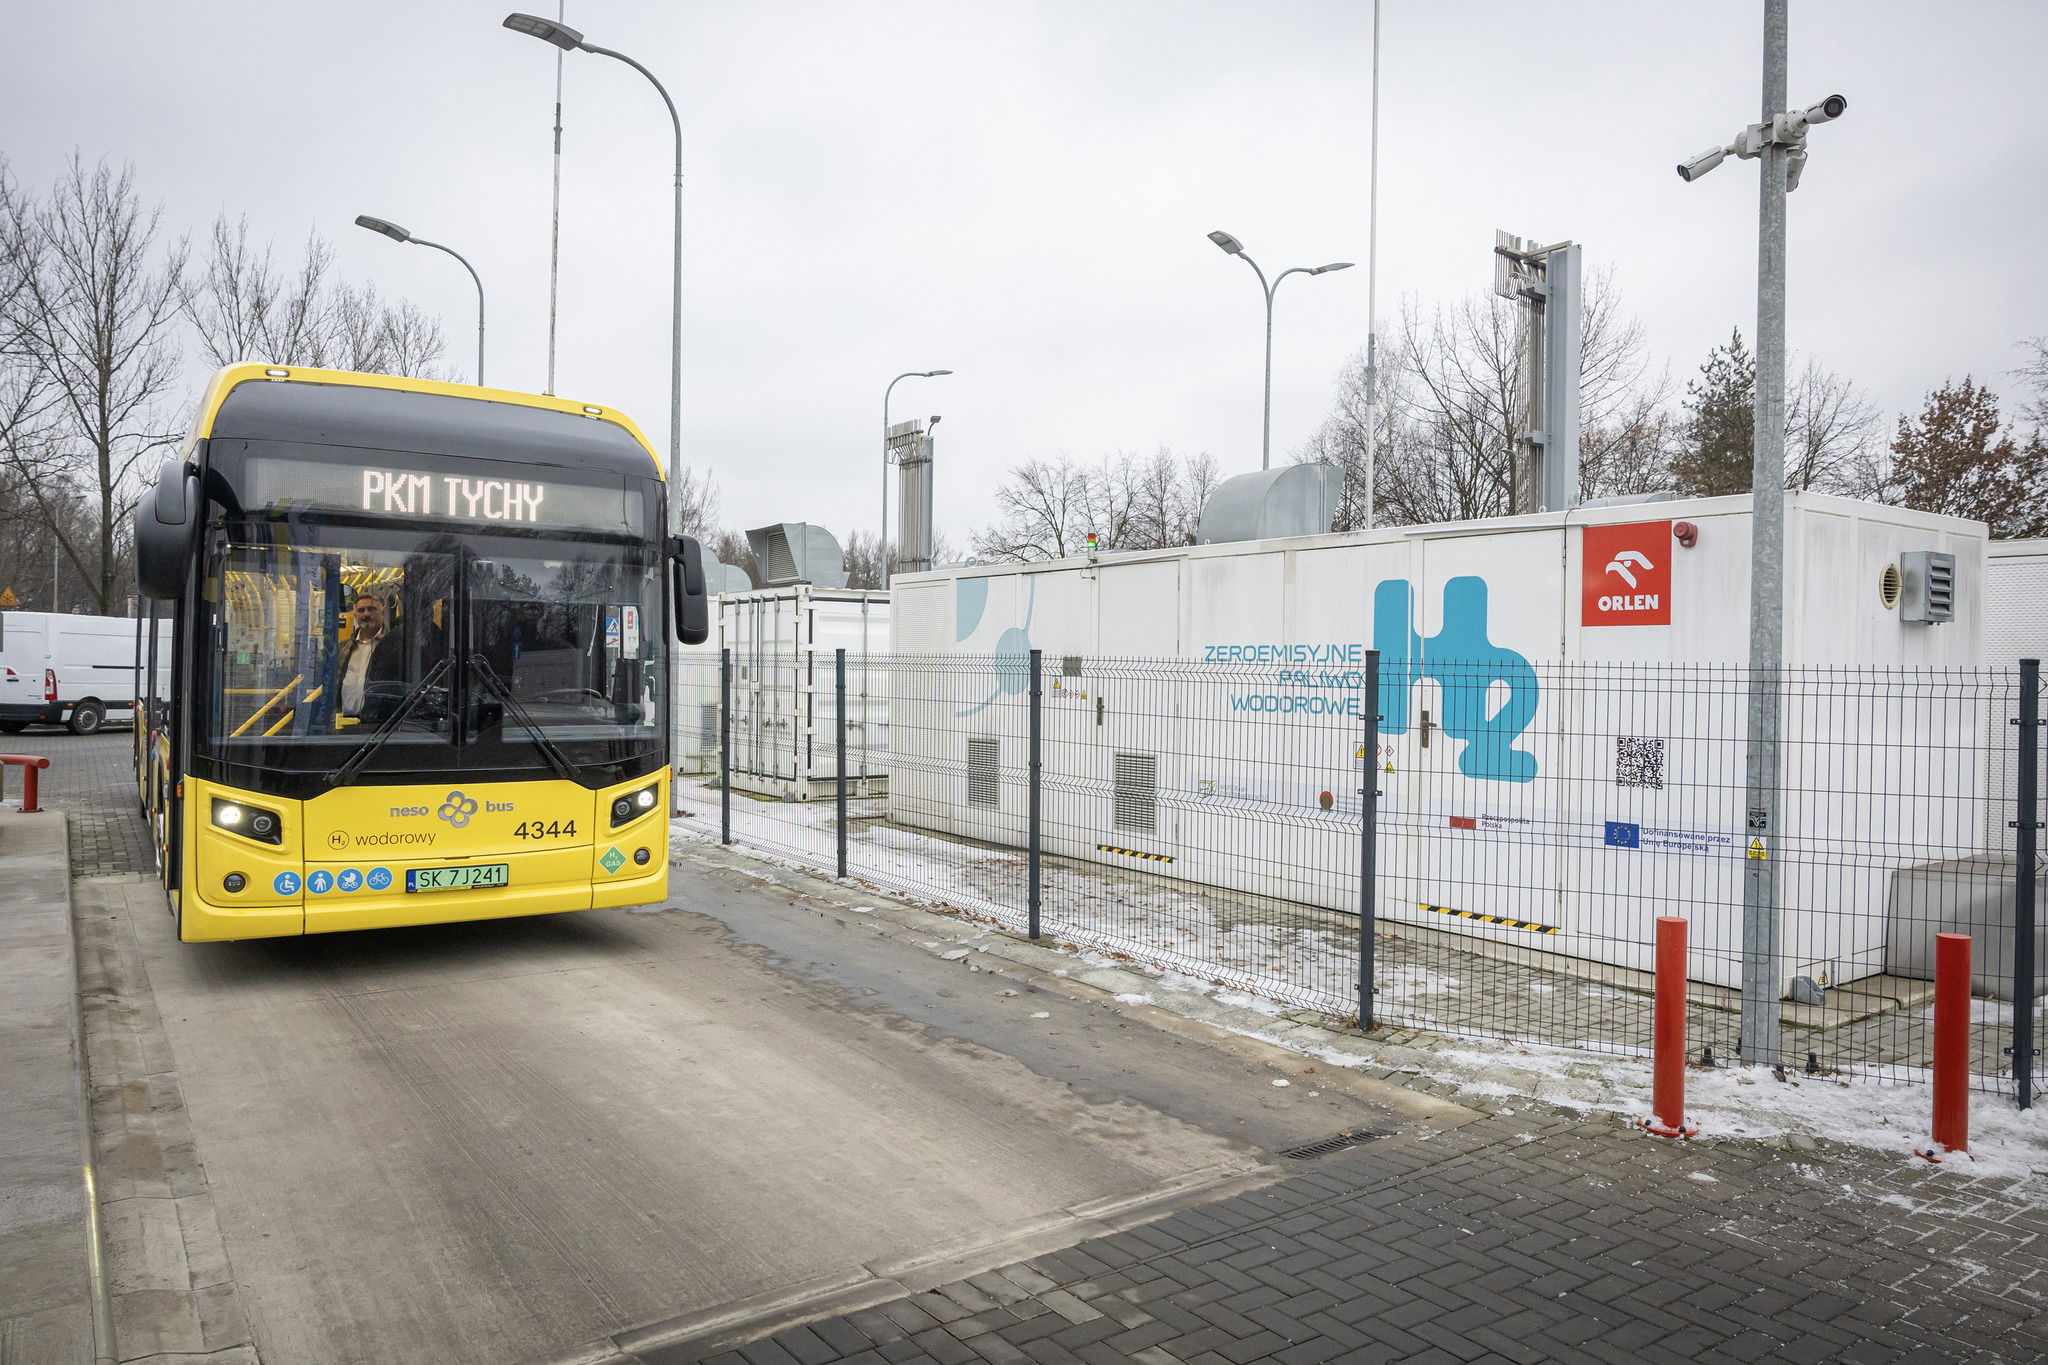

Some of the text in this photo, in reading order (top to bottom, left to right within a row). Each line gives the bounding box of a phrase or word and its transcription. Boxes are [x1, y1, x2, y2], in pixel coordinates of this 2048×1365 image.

[363, 470, 544, 522] PKM TYCHY
[1597, 594, 1659, 611] ORLEN
[1204, 644, 1363, 663] ZEROEMISYJNE
[1279, 670, 1362, 689] PALIWO
[1230, 694, 1361, 716] WODOROWE
[389, 800, 514, 818] neso bus
[355, 831, 436, 846] wodorowy
[513, 819, 577, 840] 4344
[1642, 838, 1661, 848] Unę
[1707, 835, 1731, 844] przez
[420, 871, 442, 887] SK
[449, 867, 501, 886] 7J241
